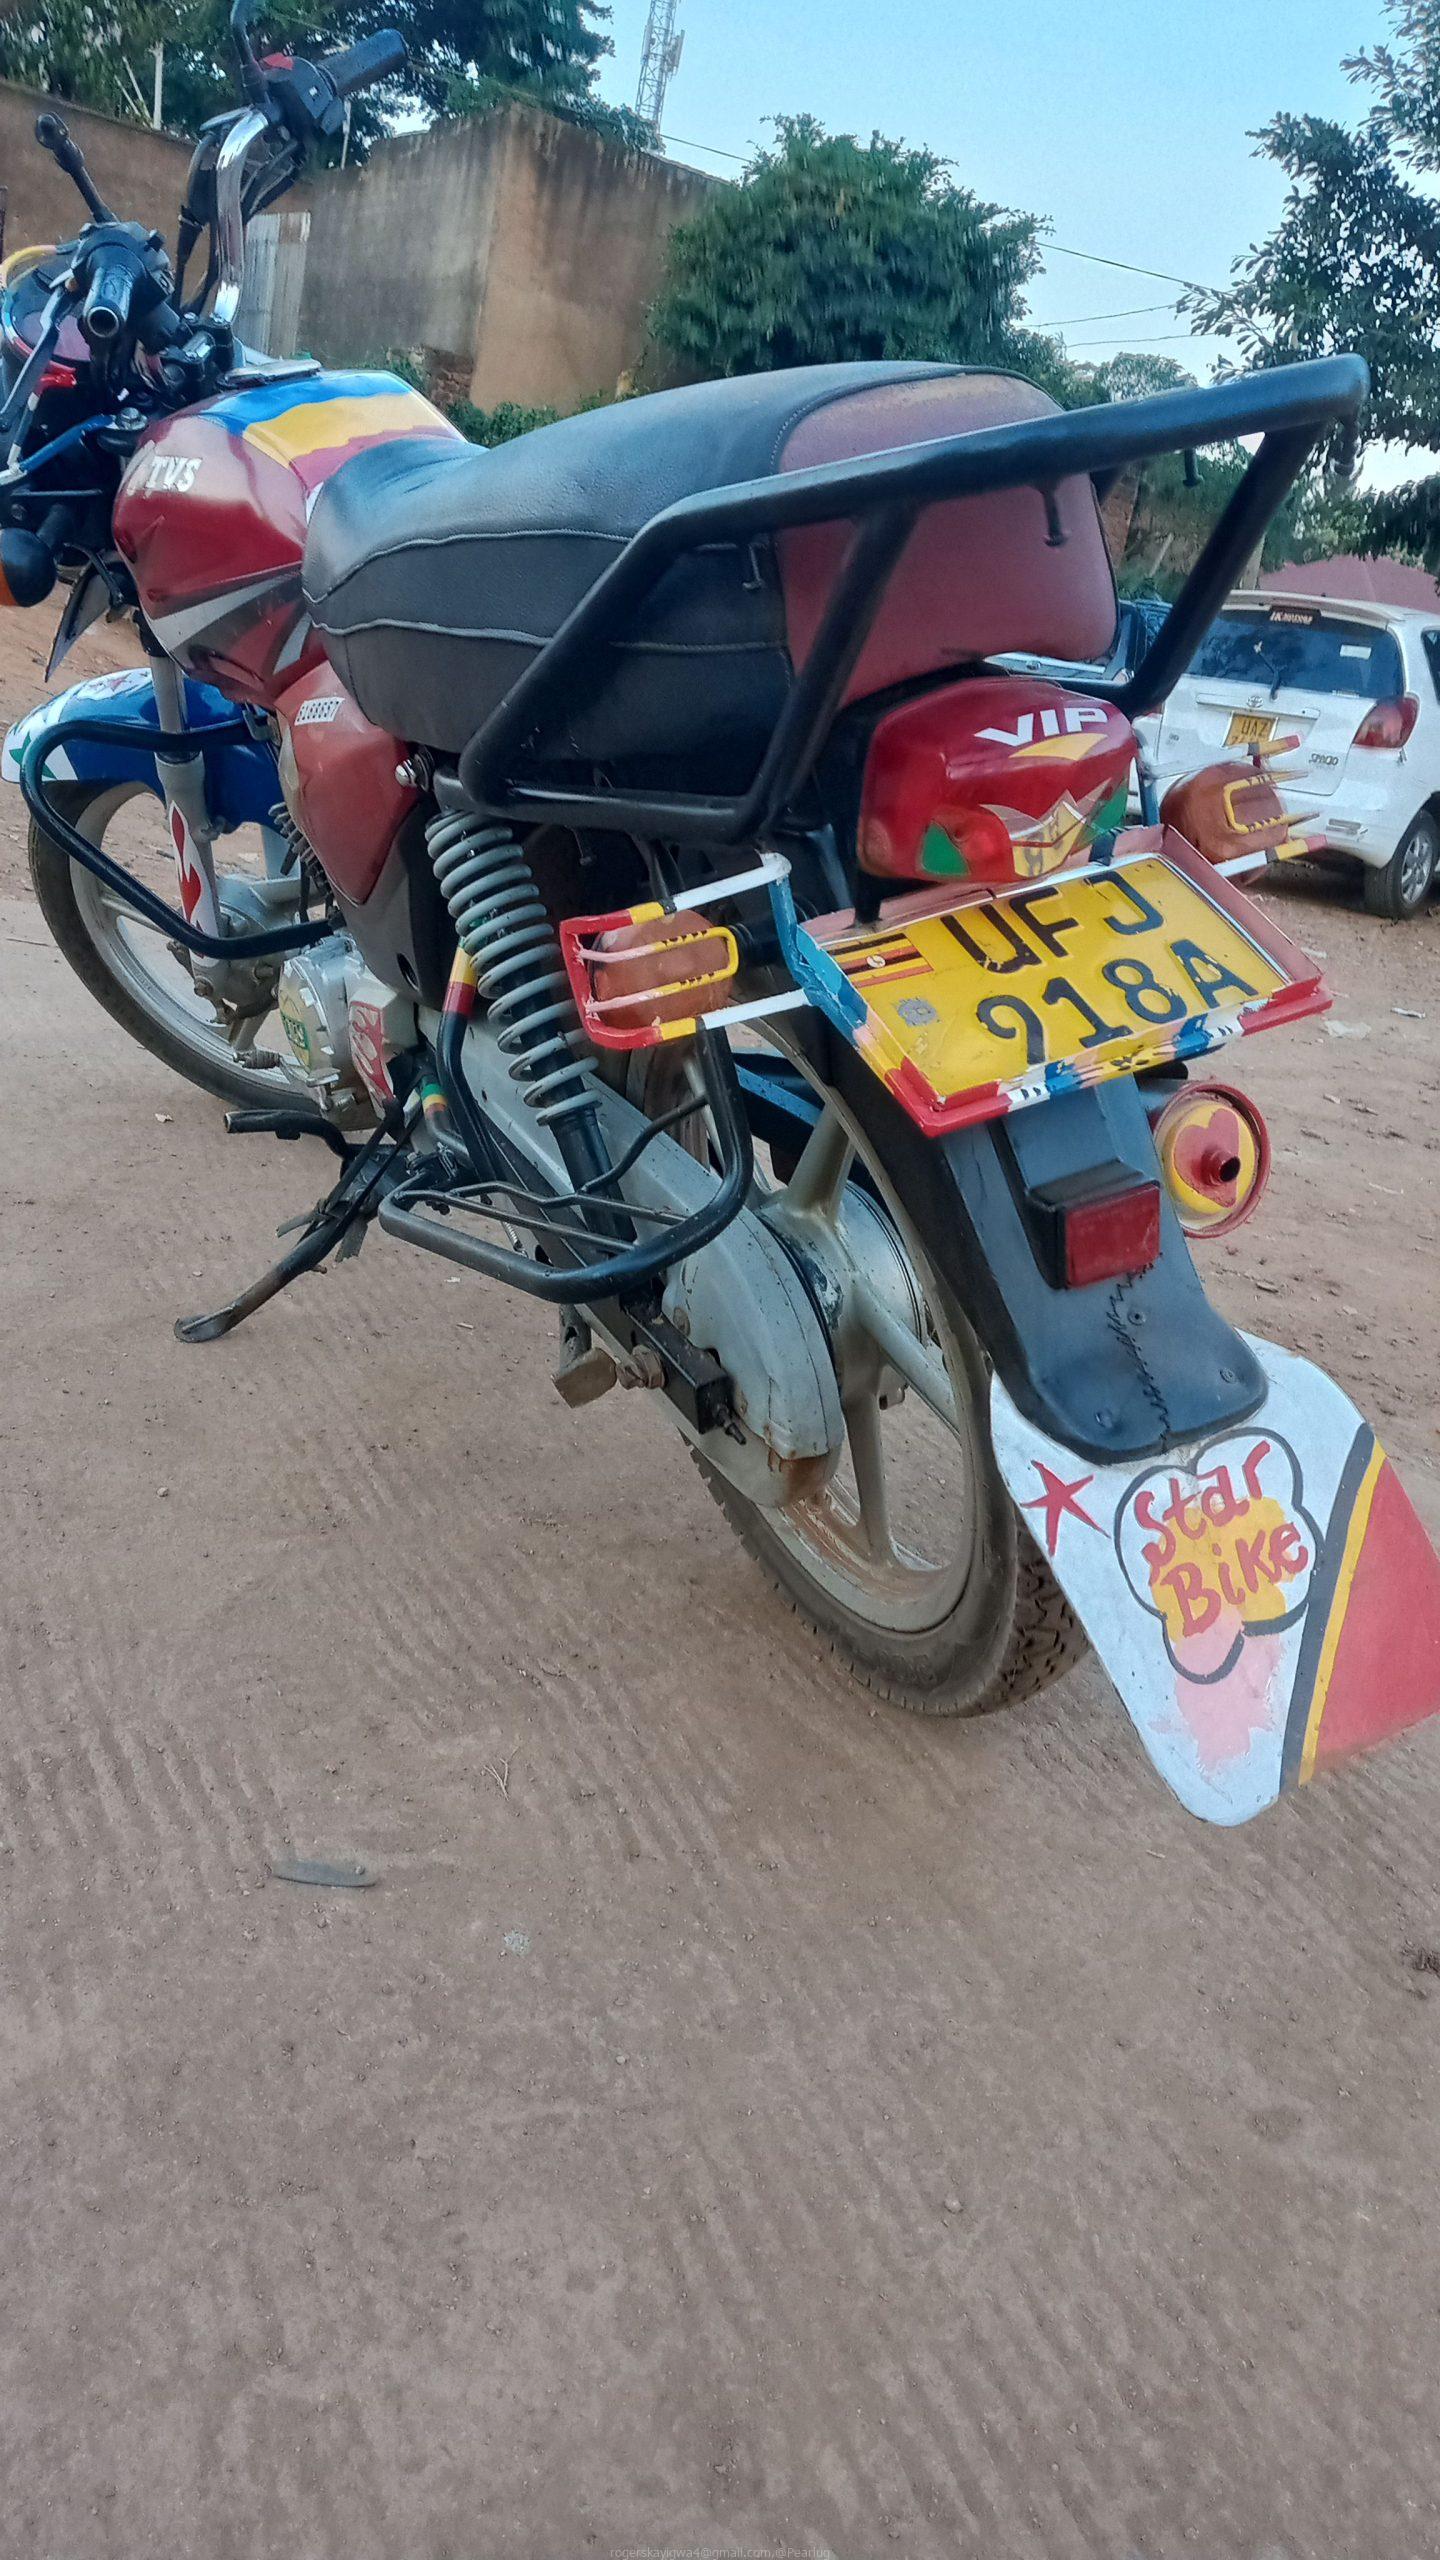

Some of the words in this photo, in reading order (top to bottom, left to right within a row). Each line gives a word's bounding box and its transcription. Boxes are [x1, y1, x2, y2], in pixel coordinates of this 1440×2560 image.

[145, 455, 203, 492] TVS
[973, 707, 1109, 747] VIP
[939, 870, 1165, 974] UFJ
[975, 938, 1259, 1065] 918A
